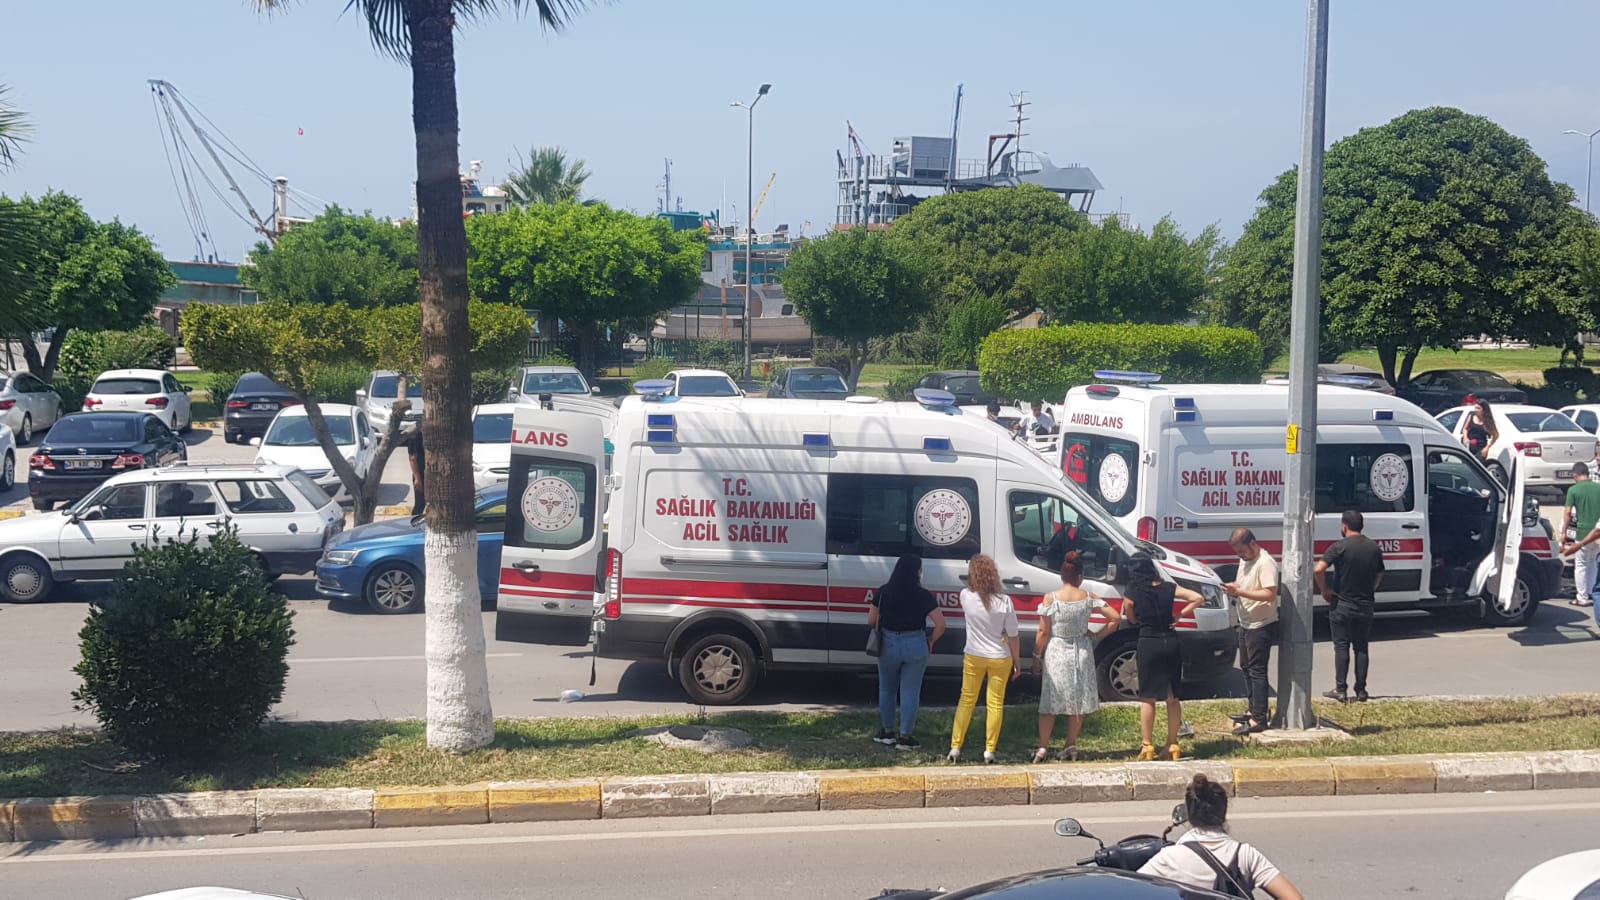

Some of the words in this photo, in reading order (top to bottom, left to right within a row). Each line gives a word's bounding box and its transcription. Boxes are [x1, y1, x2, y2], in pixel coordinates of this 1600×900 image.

[1071, 412, 1124, 430] AMBULANS
[1231, 451, 1254, 467] T.C.
[1181, 467, 1228, 486] SAĞLIK
[1234, 470, 1285, 486] BAKANL
[722, 478, 752, 497] T.C.
[1202, 488, 1231, 507] ACİL
[1236, 487, 1281, 507] SAĞLIK
[655, 495, 717, 517] SAĞLIK
[726, 498, 816, 521] BAKANLIĞI
[683, 520, 720, 542] ACİL
[727, 521, 789, 544] SAĞLIK
[1163, 516, 1185, 529] 112
